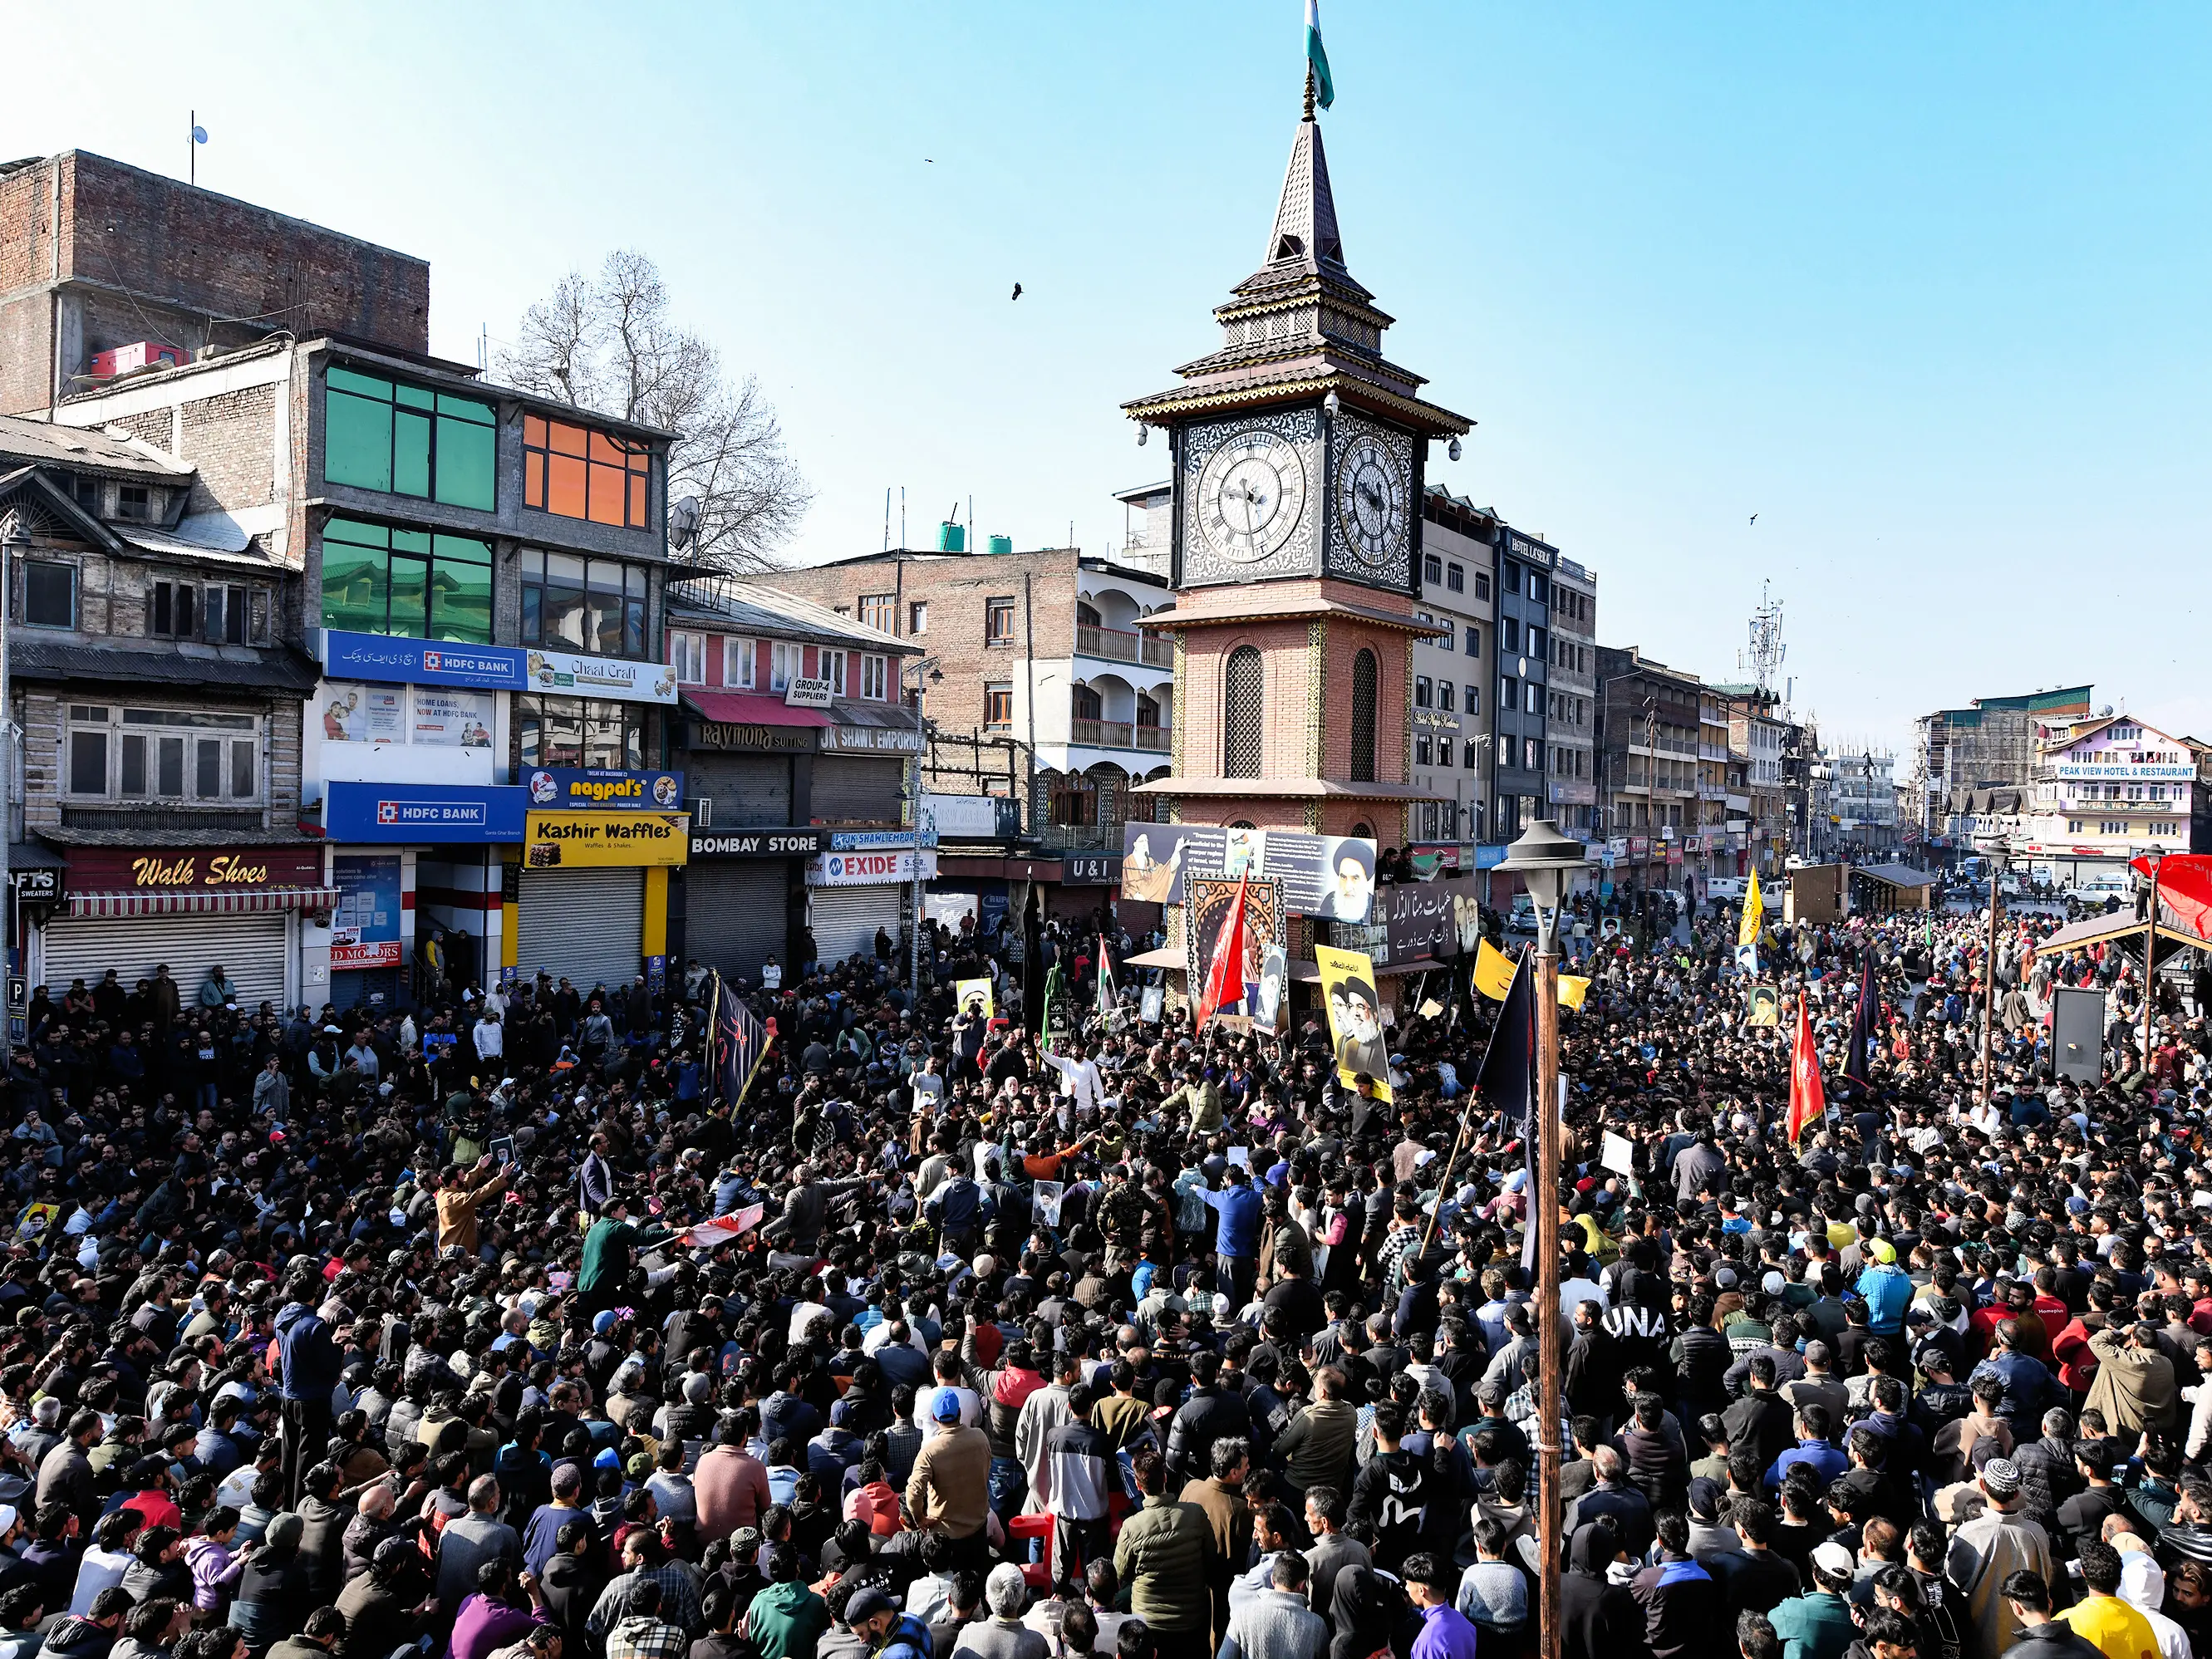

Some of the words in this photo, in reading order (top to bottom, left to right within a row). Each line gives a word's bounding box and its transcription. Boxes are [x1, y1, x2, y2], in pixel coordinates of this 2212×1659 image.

[445, 658, 474, 670] HDFC
[478, 661, 509, 672] BANK
[572, 660, 603, 677] Chaat
[607, 665, 637, 680] Craft
[795, 679, 829, 692] GROUP-4
[793, 690, 828, 701] SUPPLIERS
[773, 737, 808, 749] SUITING
[821, 726, 838, 749] JK
[841, 728, 874, 749] SHAWL
[2059, 766, 2080, 775] PEAK
[2082, 767, 2102, 776] VIEW
[2104, 767, 2130, 776] HOTEL
[2132, 767, 2138, 776] &
[2140, 768, 2194, 777] RESTAURANT
[570, 779, 642, 801] nagpal's
[403, 808, 439, 818] HDFC
[443, 808, 479, 819] BANK
[538, 822, 600, 839] Kashir
[605, 822, 671, 839] Waffles
[858, 832, 886, 844] SHAWL
[691, 837, 760, 853] BOMBAY
[769, 836, 817, 852] STORE
[133, 856, 195, 886] Walk
[205, 854, 268, 885] Shoes
[844, 855, 897, 876] EXIDE
[1074, 860, 1084, 877] U
[1089, 860, 1099, 877] &
[1103, 860, 1108, 876] I
[347, 947, 398, 960] MOORS
[15, 984, 22, 999] P
